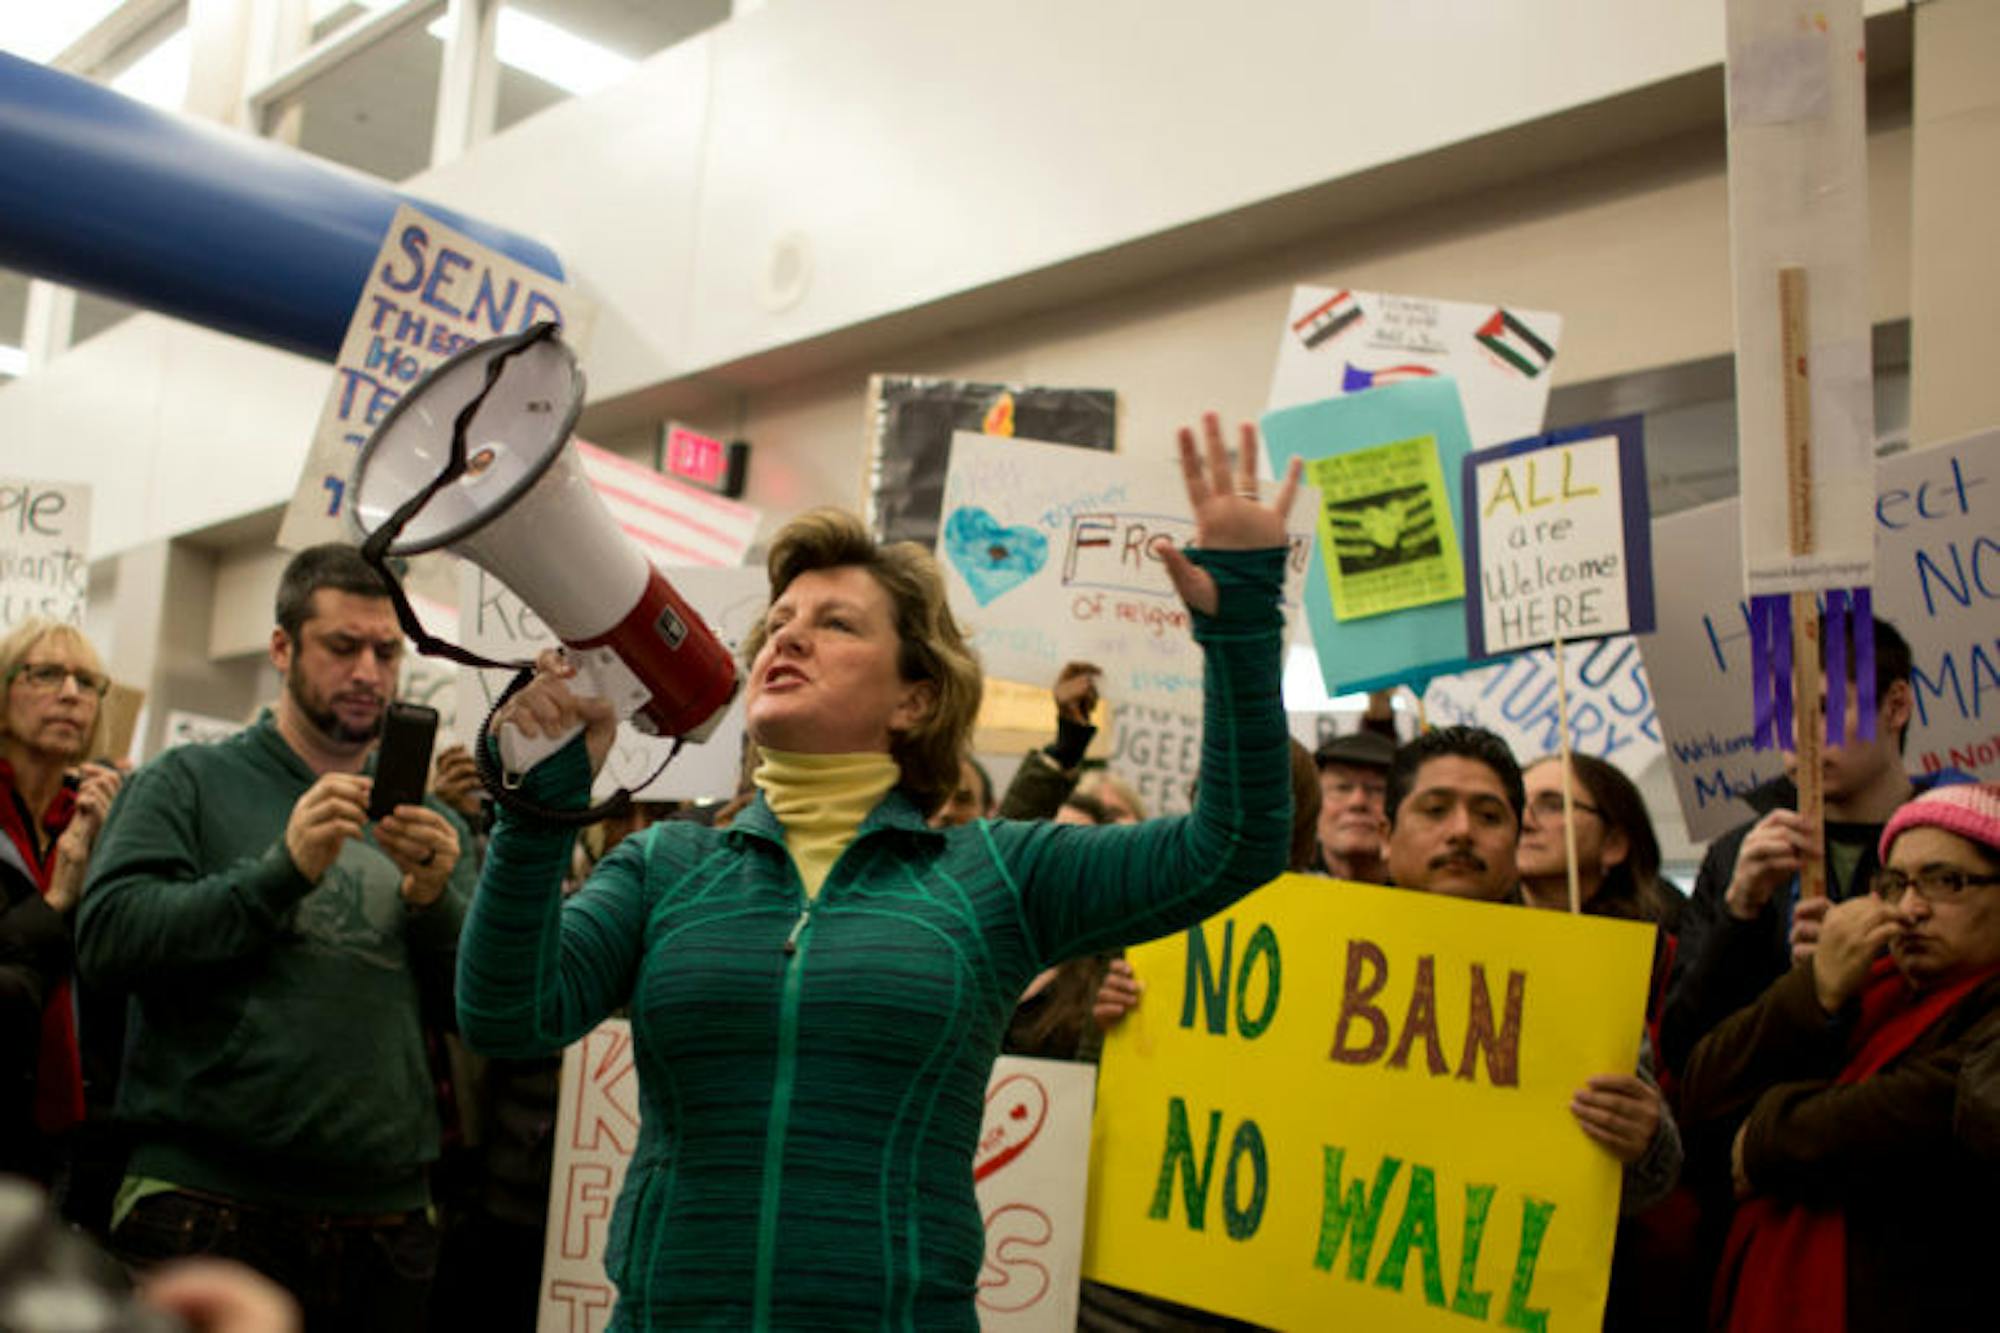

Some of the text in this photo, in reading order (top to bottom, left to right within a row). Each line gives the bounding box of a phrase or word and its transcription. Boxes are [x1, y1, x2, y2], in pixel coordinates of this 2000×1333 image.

[381, 225, 562, 334] SEND
[1483, 450, 1602, 518] ALL
[1508, 517, 1574, 549] are
[1485, 553, 1619, 604] Welcome
[1501, 588, 1603, 646] HERE
[1180, 918, 1527, 1089] NO BAN
[1147, 1096, 1557, 1333] NO WALL
